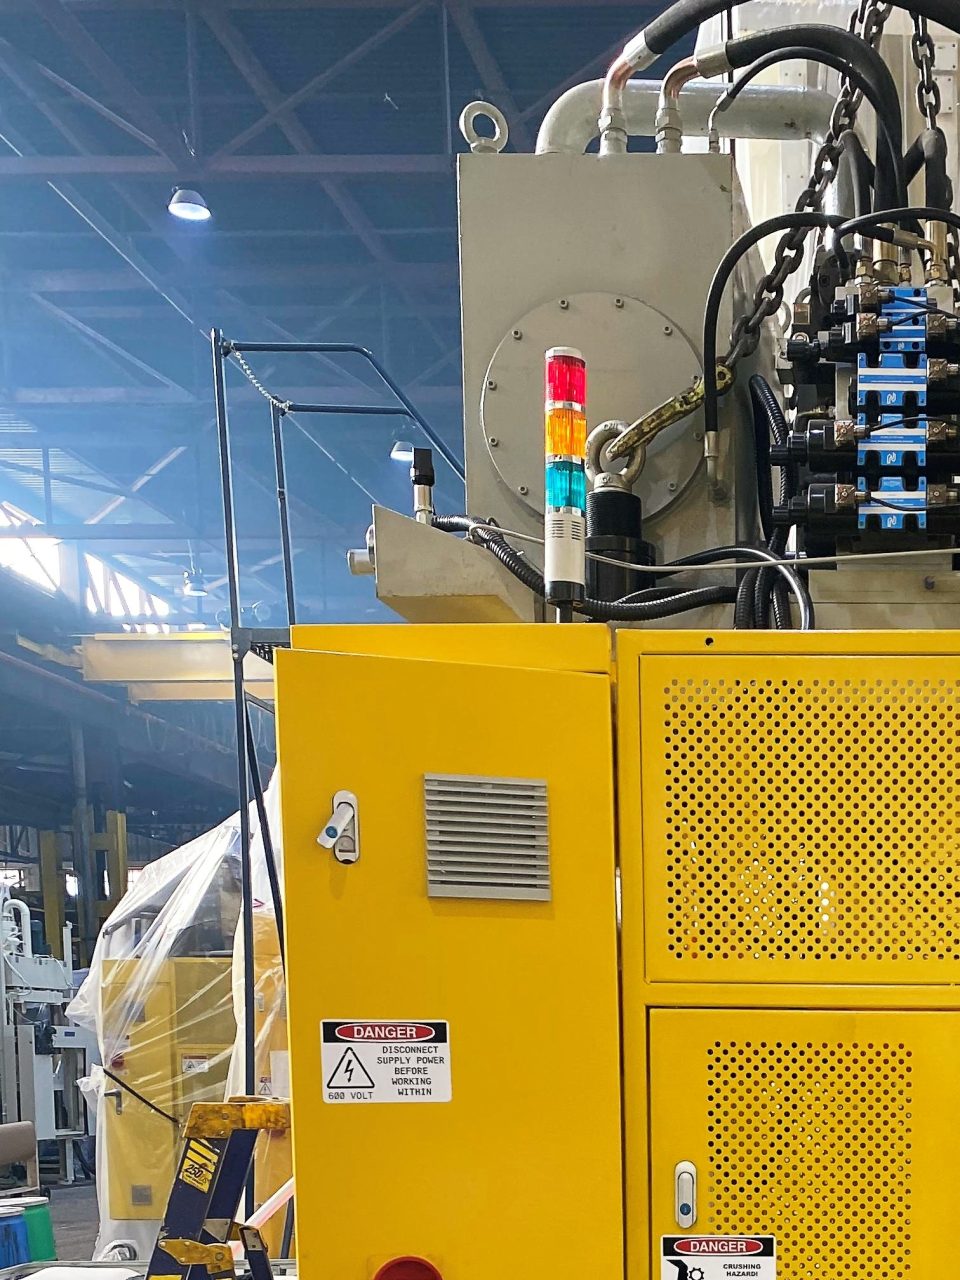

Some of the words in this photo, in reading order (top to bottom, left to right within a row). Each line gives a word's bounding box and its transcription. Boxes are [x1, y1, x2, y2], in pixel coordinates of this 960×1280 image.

[353, 1026, 417, 1038] DANGER
[382, 1045, 439, 1054] DISCONNECT
[376, 1056, 411, 1065] SUPPLY
[416, 1056, 445, 1064] POWER
[394, 1067, 428, 1075] BEFORE
[391, 1077, 432, 1086] WORKING
[328, 1091, 345, 1100] 600
[351, 1091, 374, 1100] VOLT
[397, 1088, 432, 1096] WITHIN
[185, 1164, 203, 1178] 250
[690, 1240, 747, 1252] DANGER
